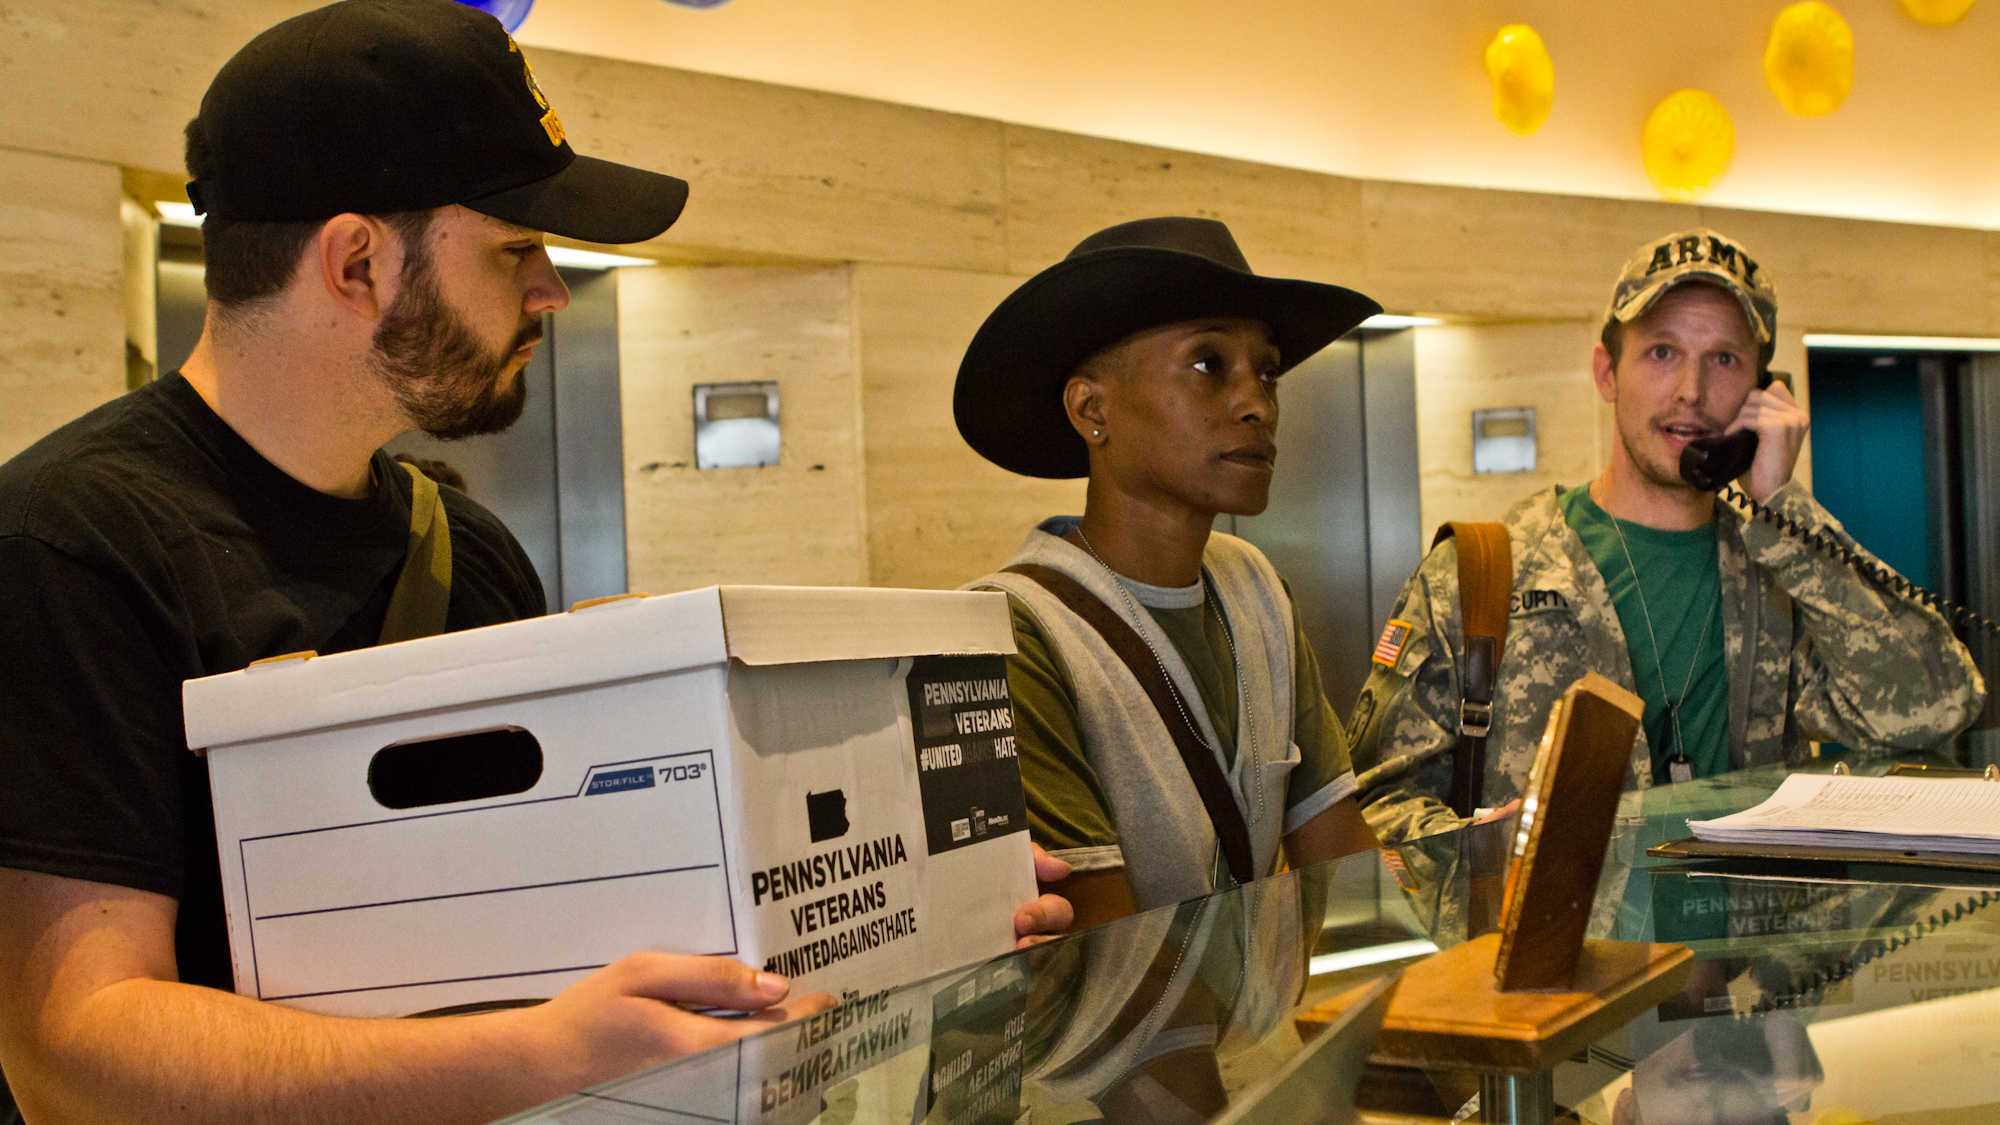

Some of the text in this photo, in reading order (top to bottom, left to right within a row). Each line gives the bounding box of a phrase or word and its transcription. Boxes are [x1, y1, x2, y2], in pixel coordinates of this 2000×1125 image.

[1645, 235, 1759, 289] ARMY
[923, 678, 1009, 706] PENNSYLVANIA
[955, 707, 1012, 735] VETERANS
[751, 833, 908, 907] PENNSYLVANIA
[790, 881, 886, 937] VETERANS
[763, 907, 917, 979] #UNITEDAGAINSTHATE
